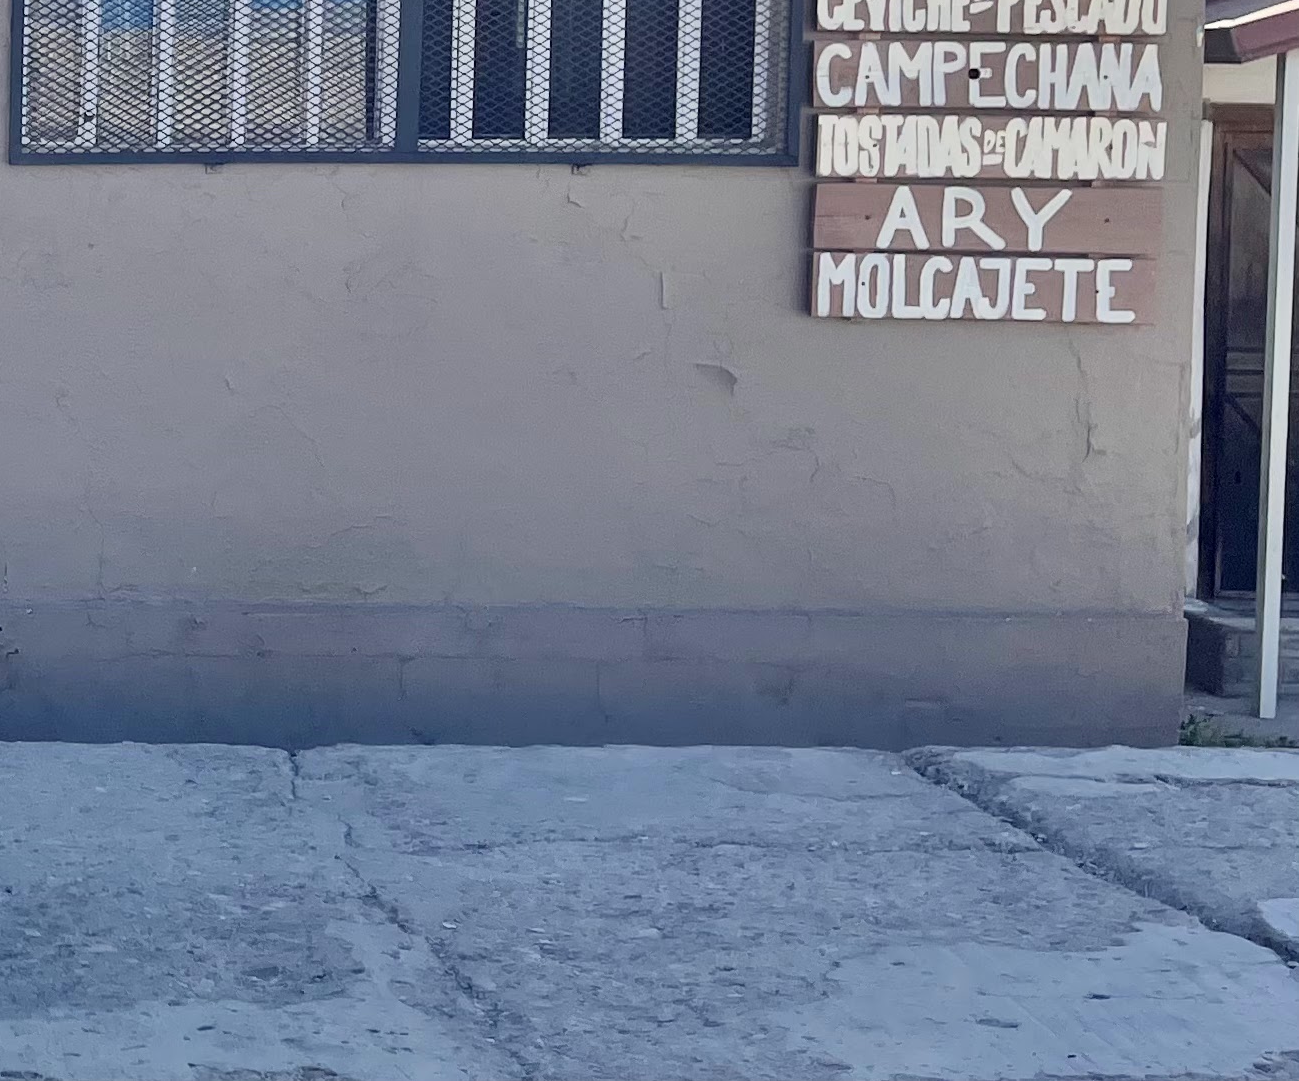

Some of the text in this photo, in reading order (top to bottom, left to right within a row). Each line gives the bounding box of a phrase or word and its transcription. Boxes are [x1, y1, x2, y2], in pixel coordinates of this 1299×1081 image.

[816, 41, 1162, 112] CAMPECHANA
[816, 114, 982, 178] TOSTADAS
[1004, 116, 1167, 180] CAMARON
[817, 252, 1135, 322] MOLCAJETE
